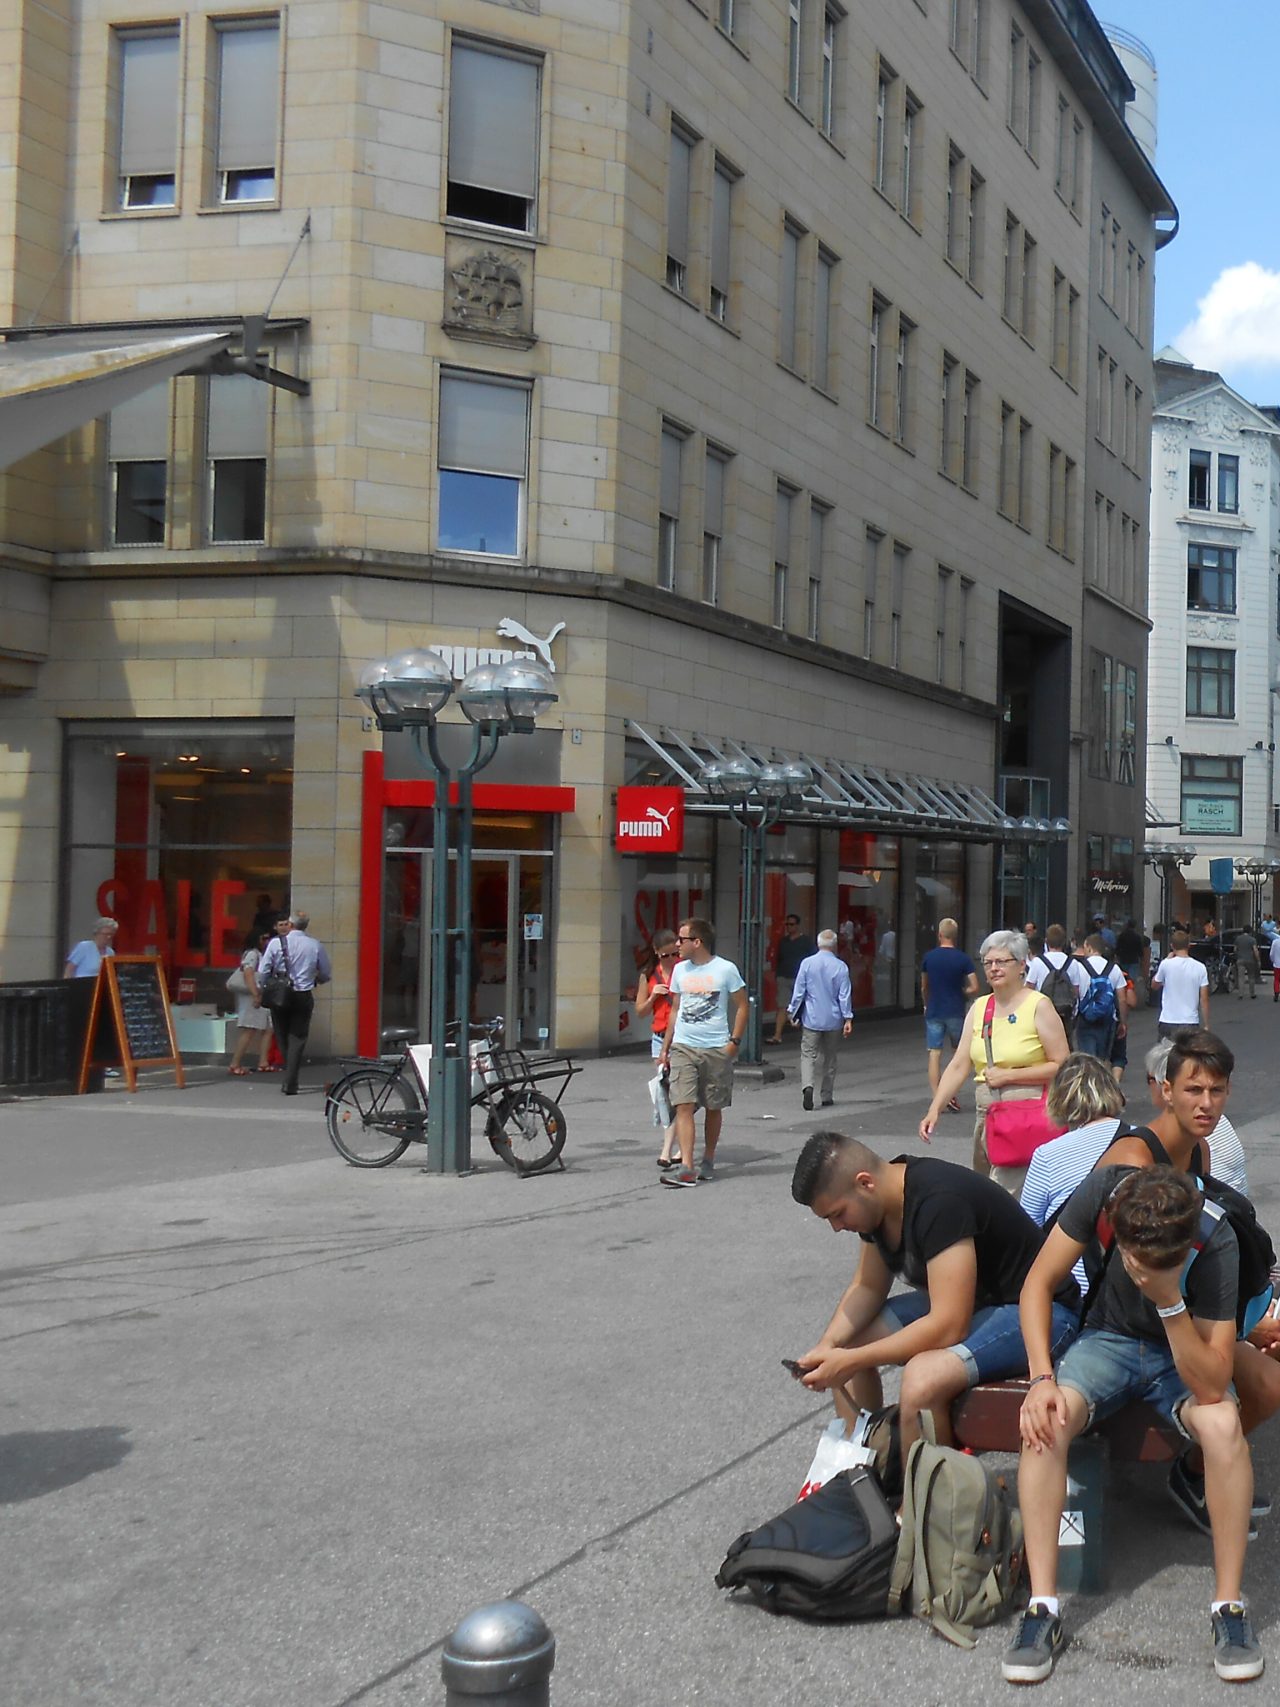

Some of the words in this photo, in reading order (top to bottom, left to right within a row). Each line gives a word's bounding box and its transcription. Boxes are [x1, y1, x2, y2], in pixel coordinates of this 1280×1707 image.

[619, 821, 662, 837] PUMA
[1092, 877, 1129, 894] Möhring
[96, 878, 247, 969] SALE
